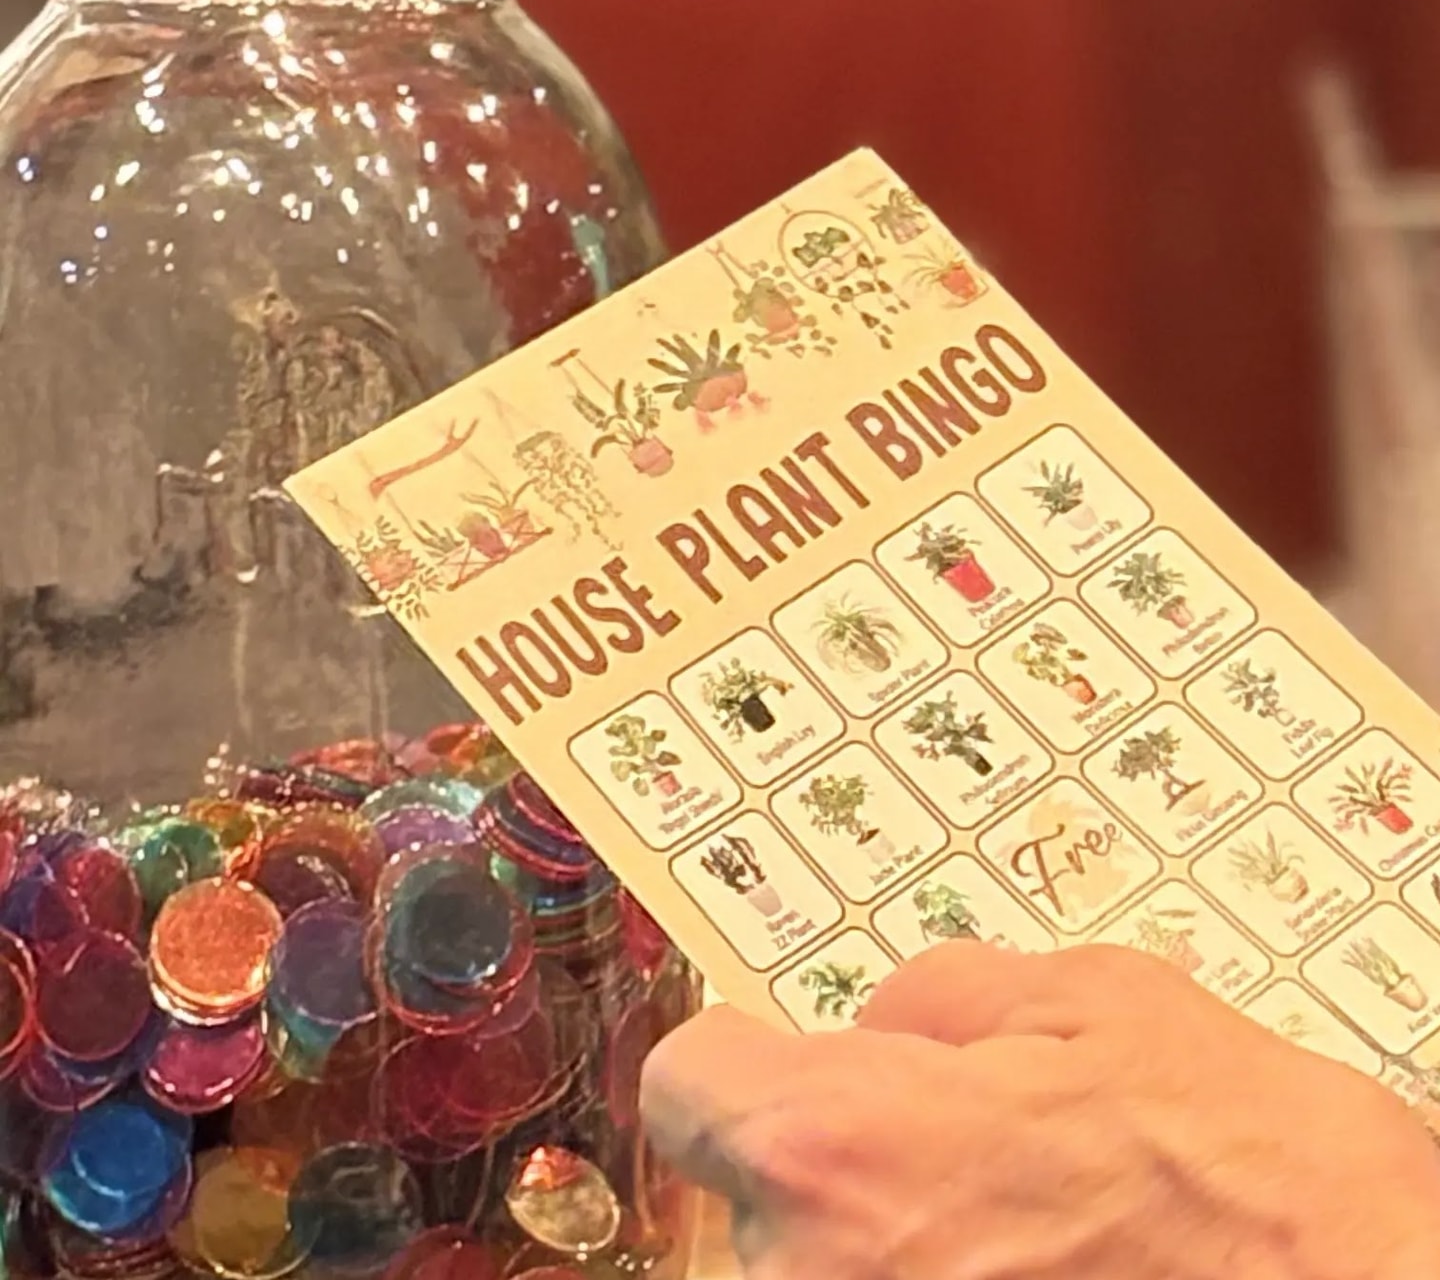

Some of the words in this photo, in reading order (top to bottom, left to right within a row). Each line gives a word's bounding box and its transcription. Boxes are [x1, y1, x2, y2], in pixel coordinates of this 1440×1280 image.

[455, 555, 683, 726] HOUSE
[655, 431, 871, 604] PLANT
[844, 322, 1048, 482] BINGO
[1009, 822, 1123, 919] Free
